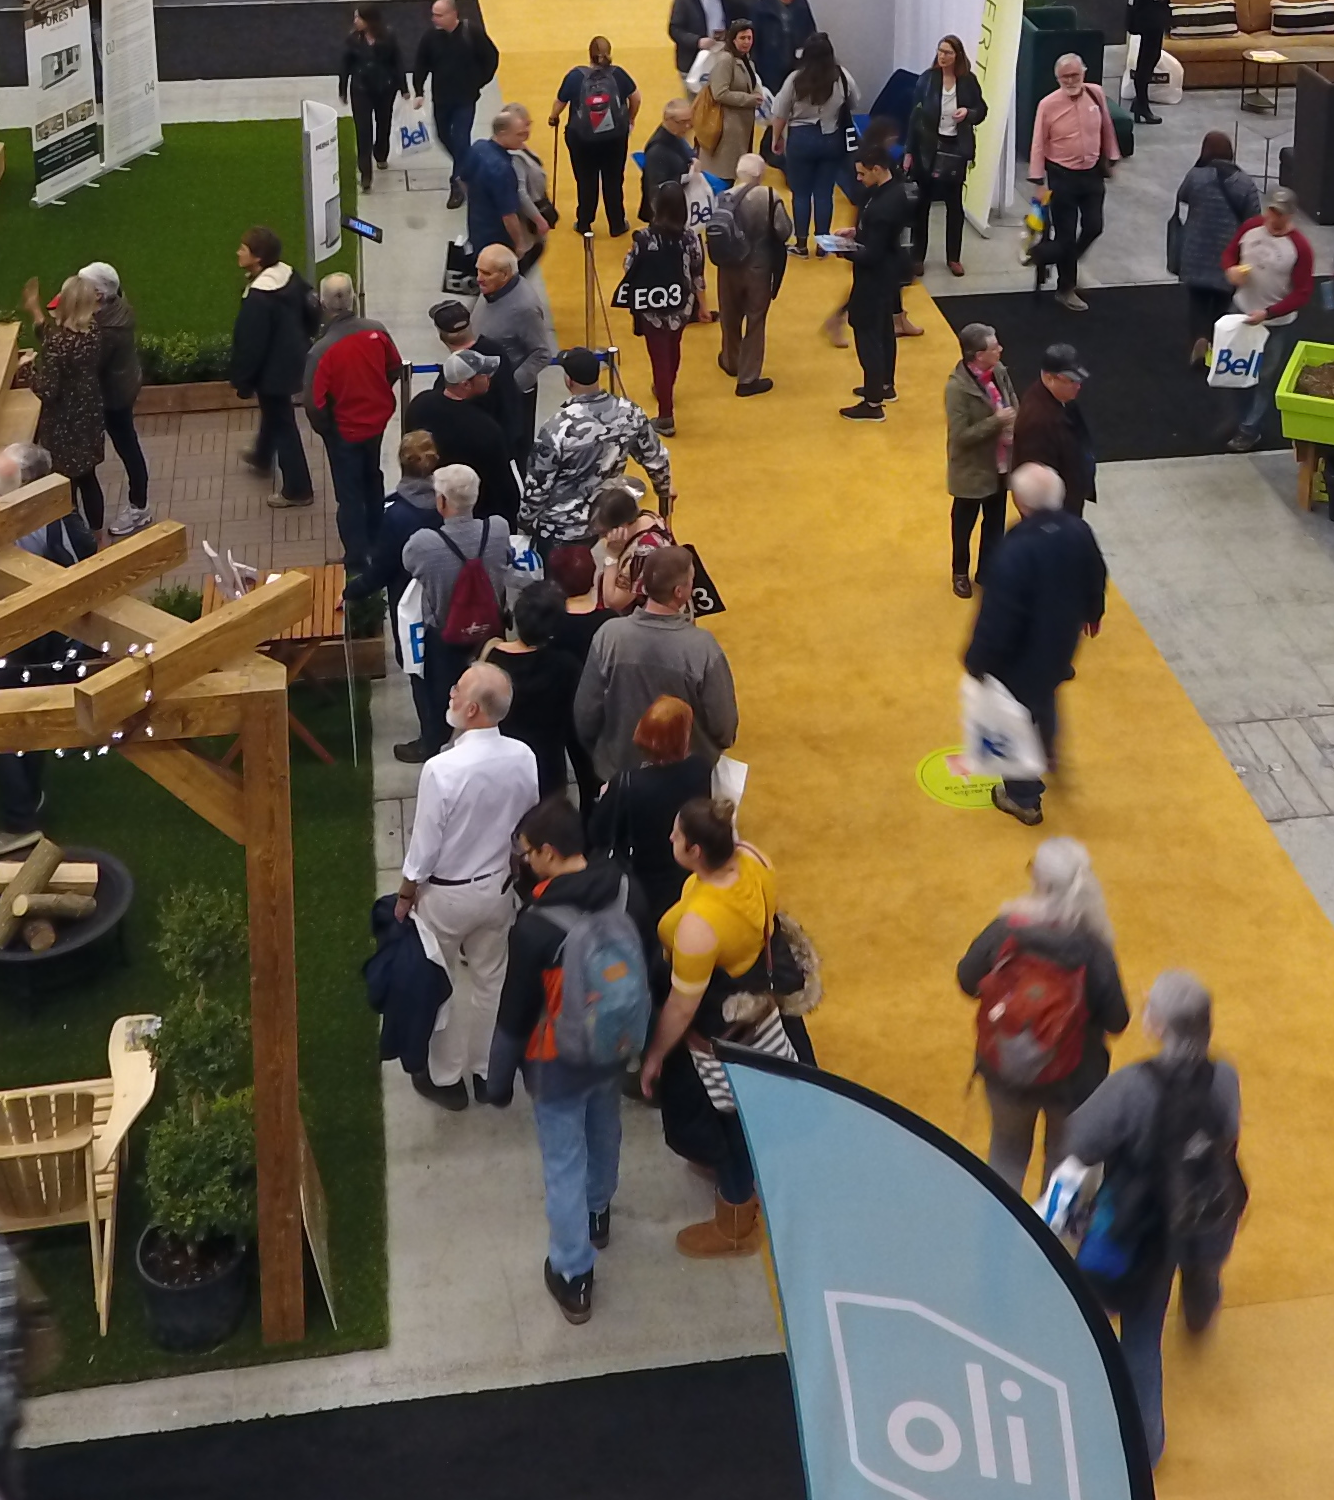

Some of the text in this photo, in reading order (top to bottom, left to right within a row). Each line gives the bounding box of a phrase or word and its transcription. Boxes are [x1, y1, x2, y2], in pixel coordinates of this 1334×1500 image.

[41, 6, 75, 30] FOREST
[106, 40, 115, 56] 03
[145, 80, 155, 96] 04
[401, 120, 429, 150] Bell
[635, 284, 681, 310] EQ3
[1215, 348, 1265, 378] Bell
[887, 1362, 1033, 1485] oli
